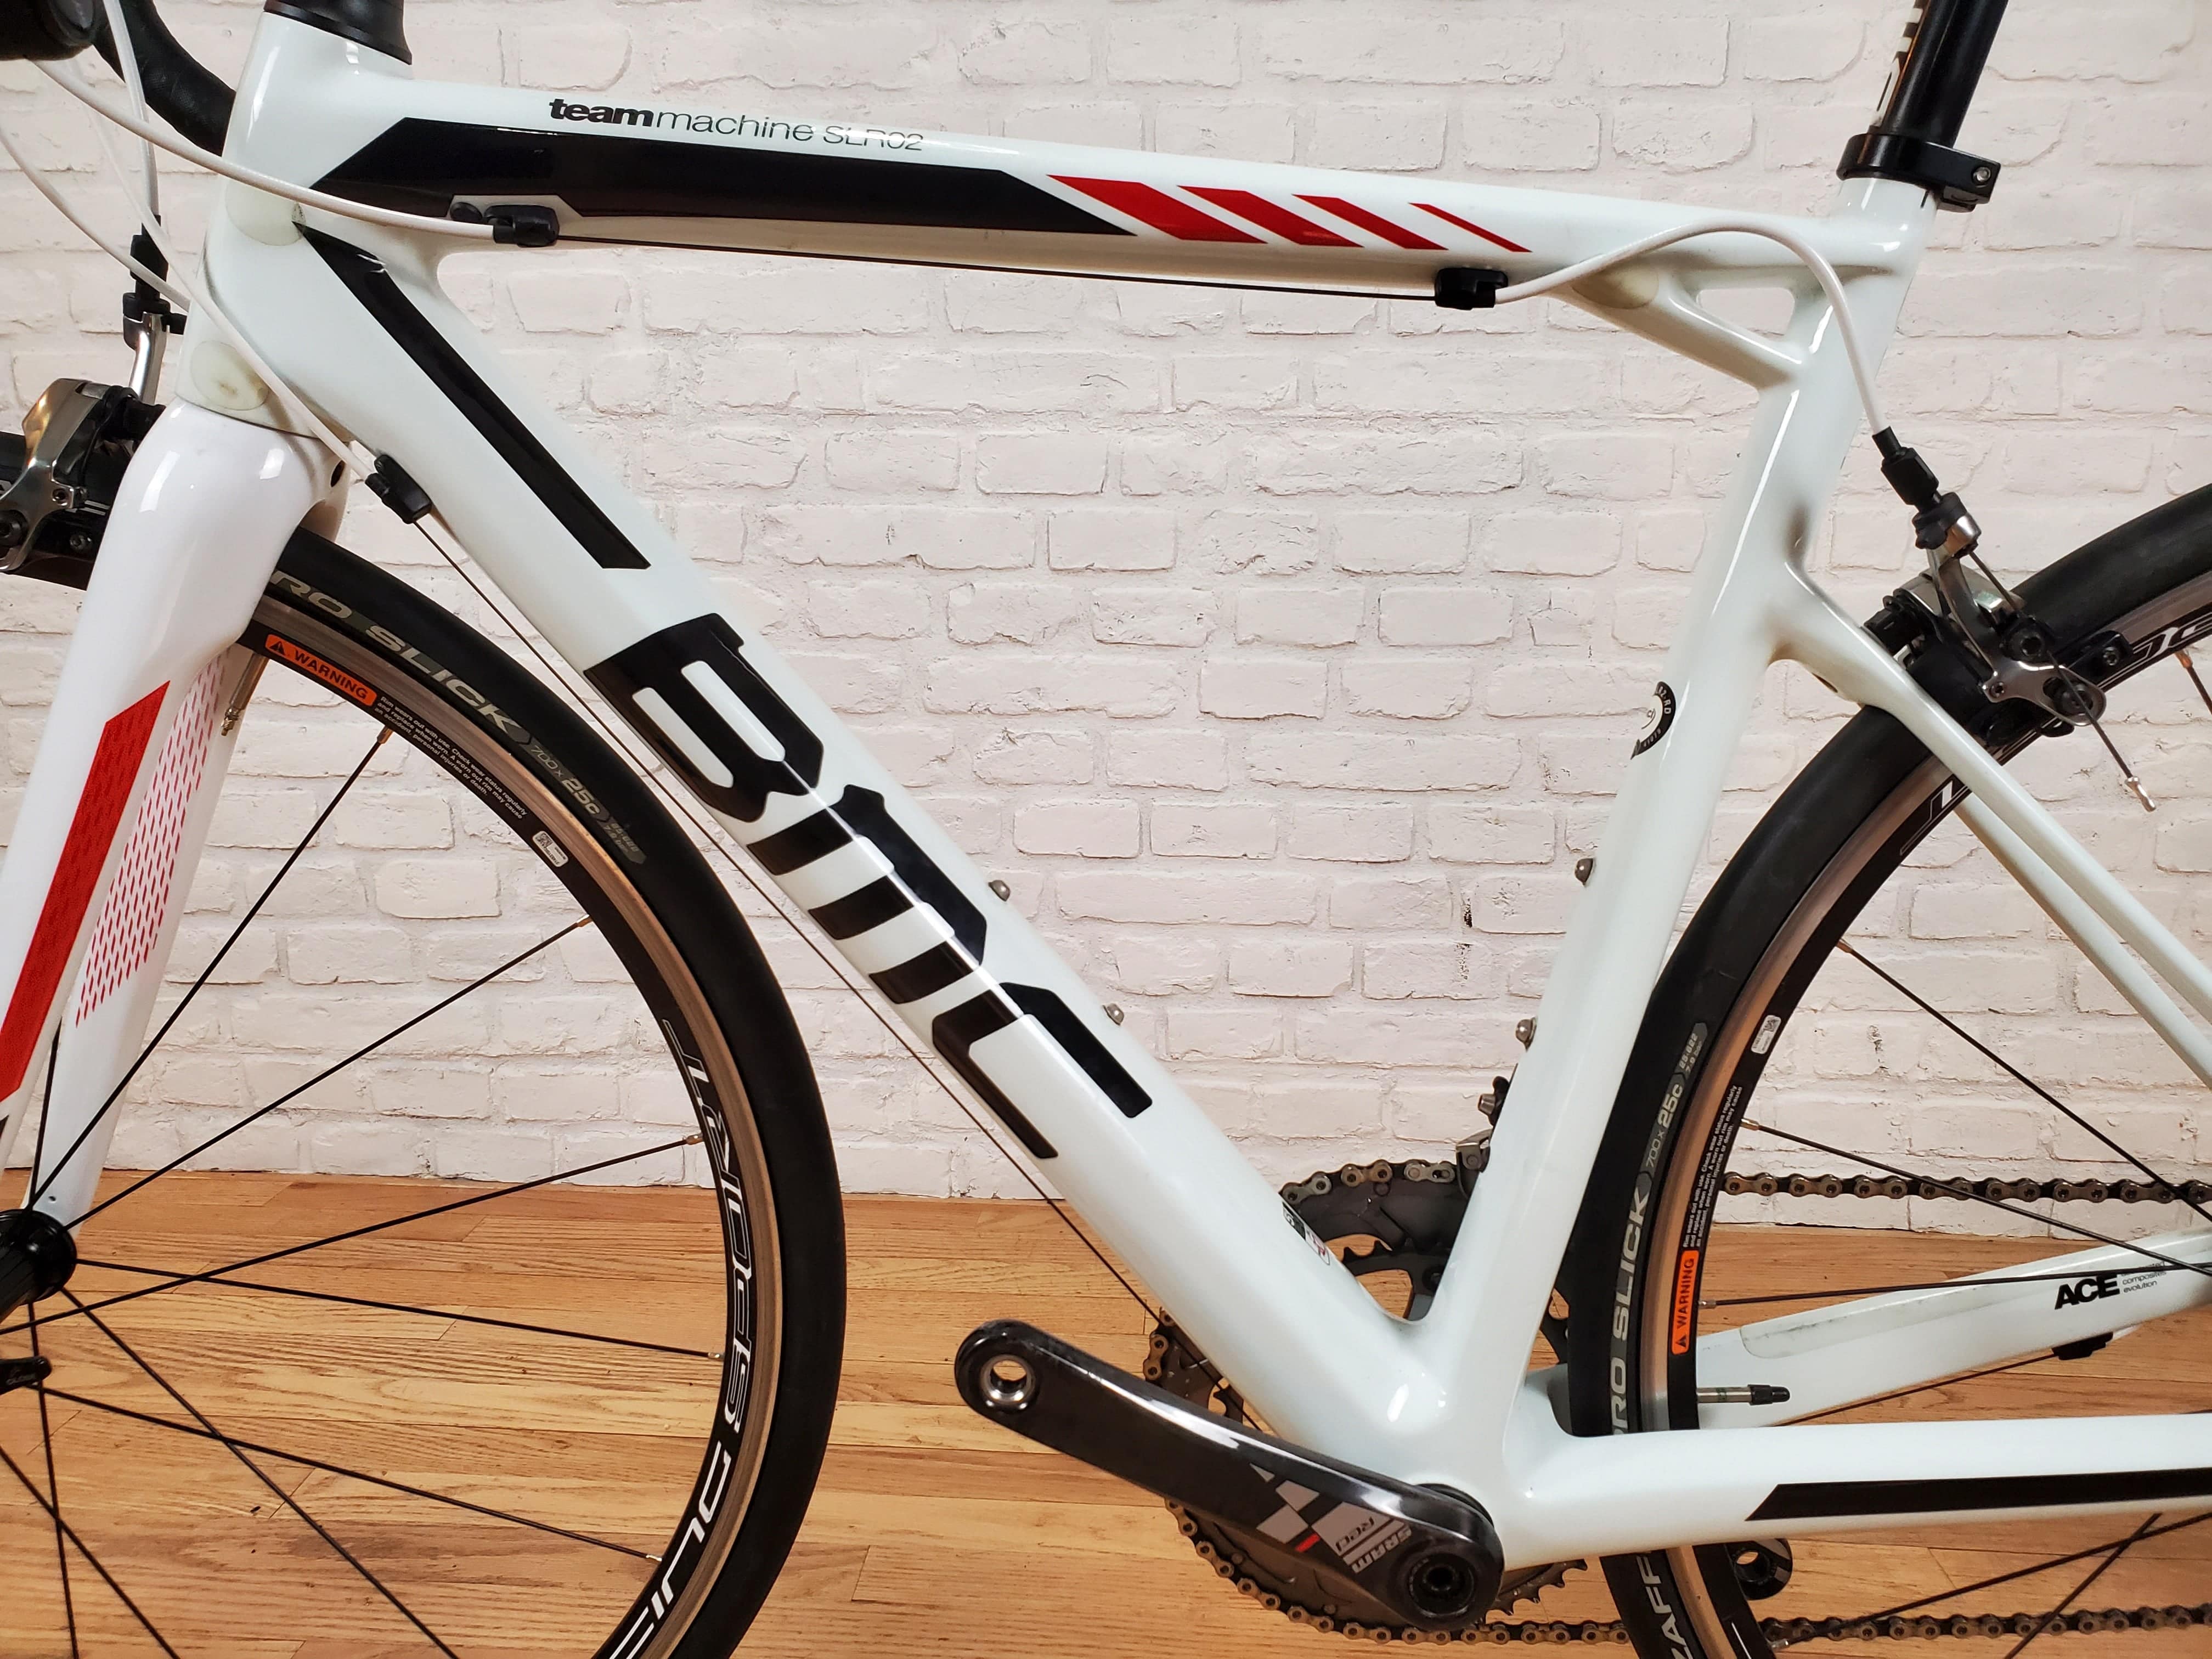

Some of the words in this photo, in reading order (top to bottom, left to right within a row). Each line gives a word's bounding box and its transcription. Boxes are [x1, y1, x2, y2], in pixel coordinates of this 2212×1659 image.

[549, 99, 814, 142] teammachine
[823, 125, 924, 151] SLR02
[294, 648, 369, 699] WARNING
[365, 625, 521, 734] SLICK
[377, 703, 391, 712] and
[391, 712, 415, 729] replace
[415, 728, 432, 742] when
[456, 759, 471, 773] worn
[472, 773, 483, 782] out
[482, 781, 493, 792] rim
[492, 791, 505, 803] may
[505, 803, 522, 819] cause
[381, 697, 394, 707] Rim
[395, 707, 413, 721] wears
[414, 720, 425, 729] out
[425, 727, 438, 739] with
[438, 738, 450, 749] use.
[452, 748, 471, 765] Check
[471, 764, 486, 777] wear
[485, 776, 503, 793] status
[503, 792, 527, 816] regularly
[413, 735, 440, 755] personal
[440, 754, 462, 774] injuries
[583, 613, 1152, 1158] BMC
[1657, 1084, 1683, 1128] 25c
[1702, 1153, 1712, 1172] Check
[1714, 1115, 1725, 1134] status
[1722, 1085, 1737, 1114] regularly
[1693, 1210, 1702, 1233] replace
[1711, 1147, 1719, 1164] worn
[1725, 1108, 1735, 1121] may
[1731, 1086, 1742, 1107] cause
[1705, 1179, 1716, 1207] personal
[1712, 1154, 1723, 1177] injuries
[661, 1019, 752, 1434] SPORT
[1612, 1187, 1651, 1341] SLICK
[1676, 1257, 1695, 1329] WARNING
[2055, 1272, 2120, 1310] ACE
[2124, 1280, 2157, 1293] evolution
[1610, 1357, 1628, 1435] RO
[1352, 1525, 1412, 1573] SRAM
